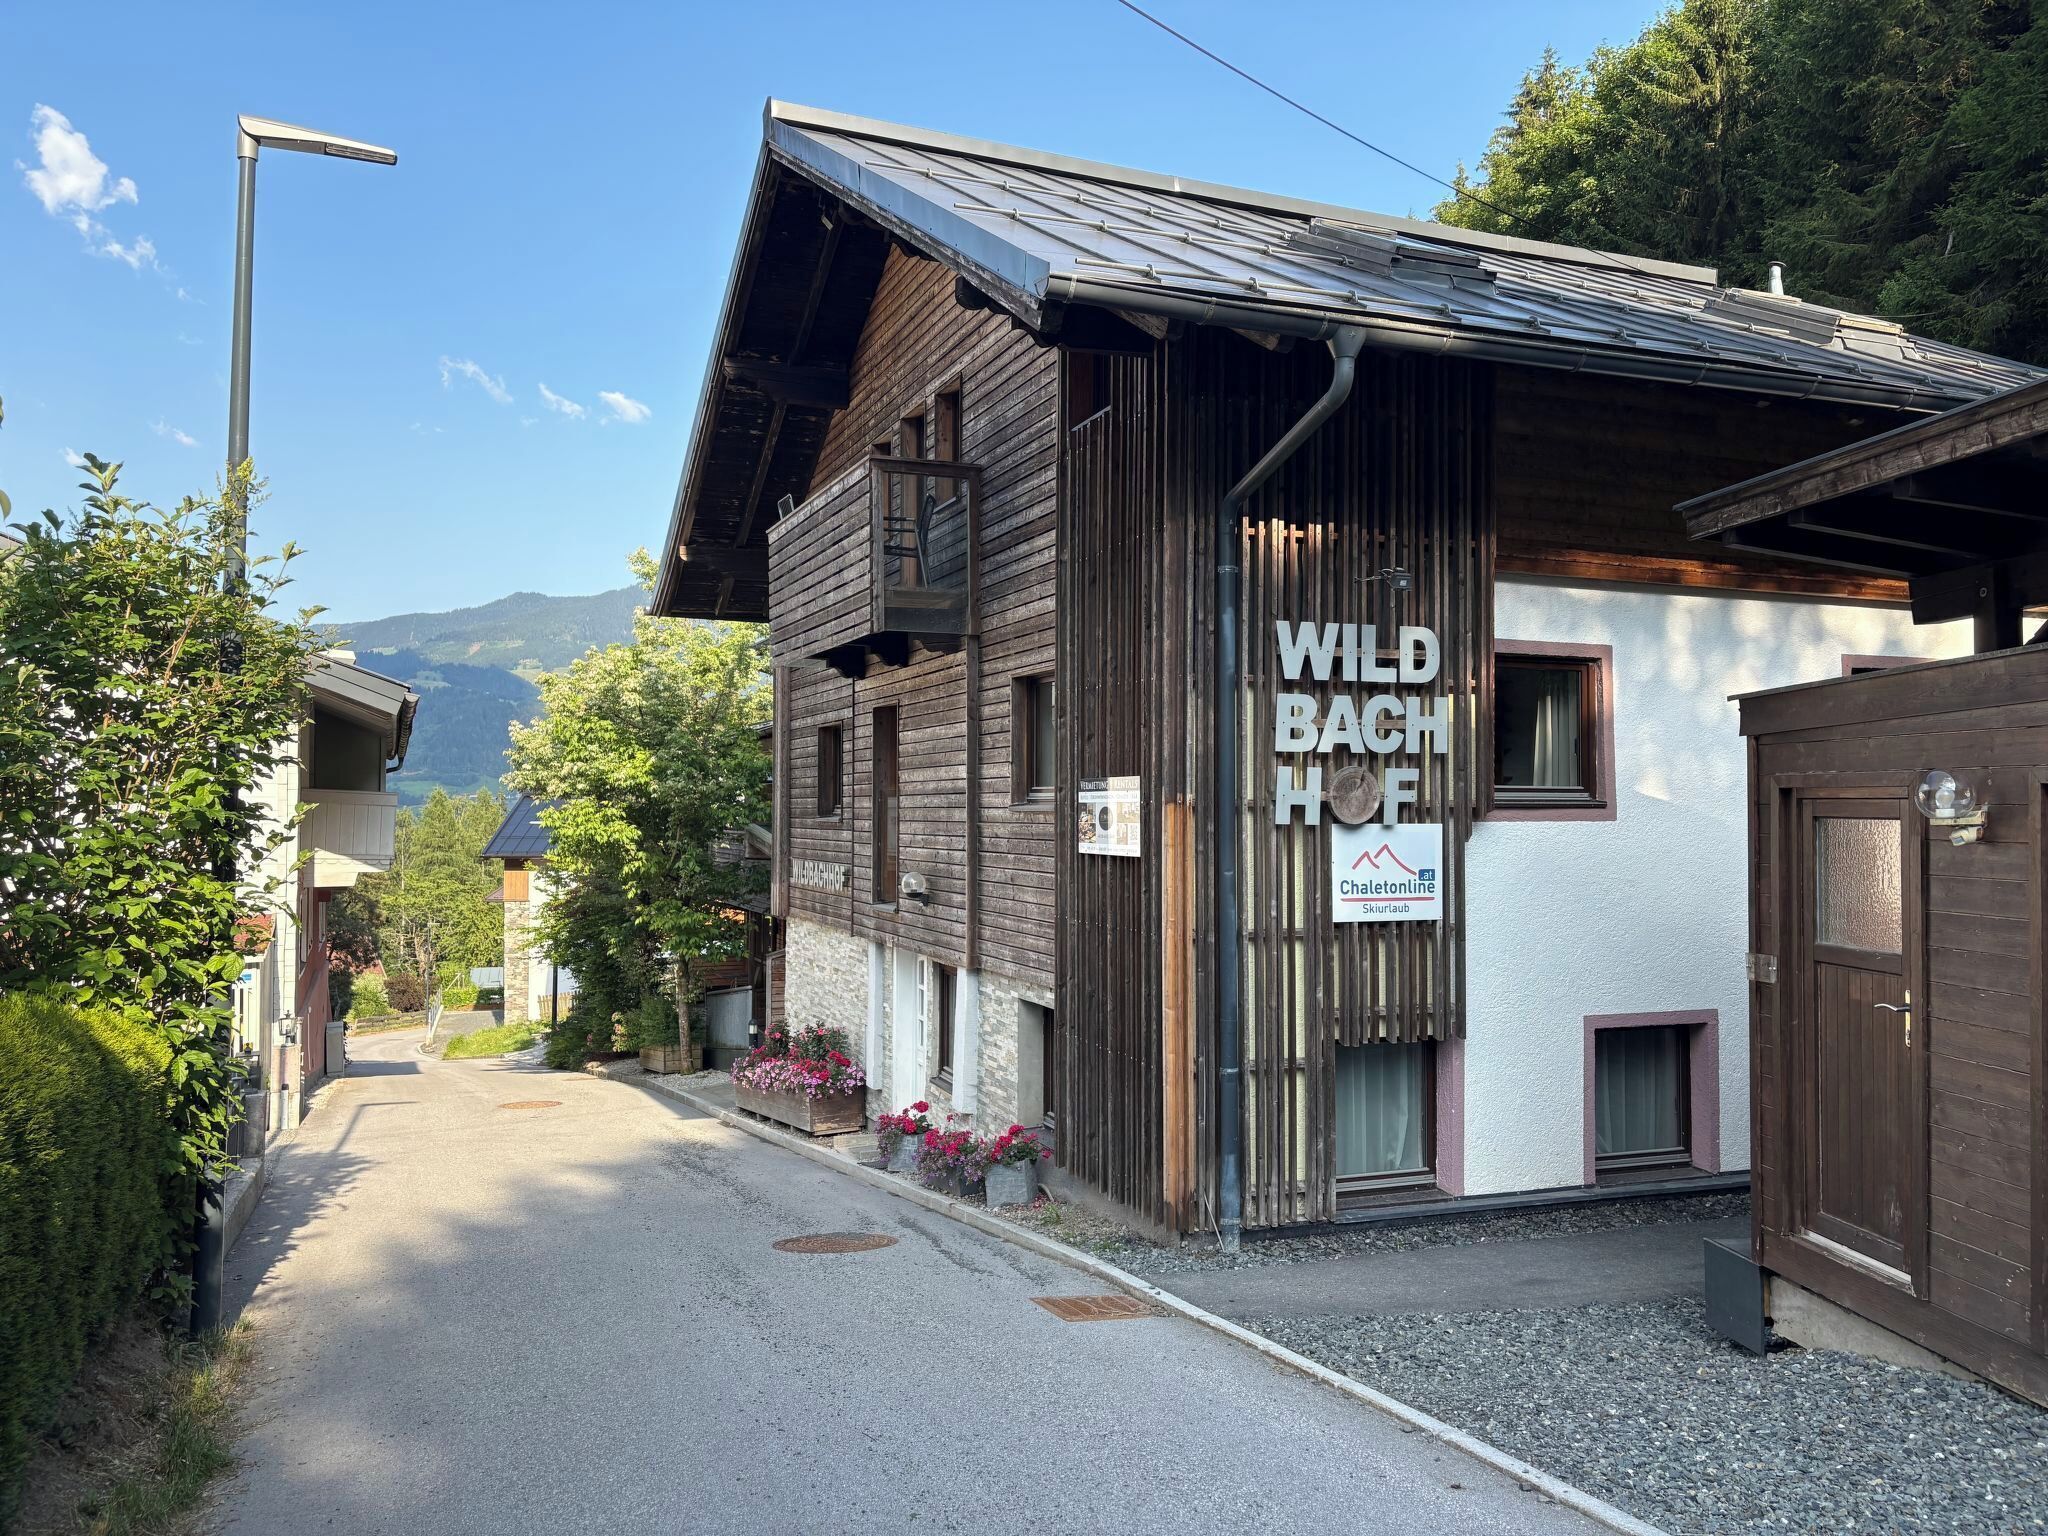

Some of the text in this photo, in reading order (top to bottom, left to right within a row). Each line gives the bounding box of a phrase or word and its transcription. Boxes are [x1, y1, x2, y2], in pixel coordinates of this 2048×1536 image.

[1275, 620, 1440, 684] WILD
[1275, 693, 1448, 754] BACH
[793, 859, 845, 891] WILDBACHHOF
[1340, 879, 1435, 895] Chaletonline
[1362, 903, 1410, 914] Skiurlaub
